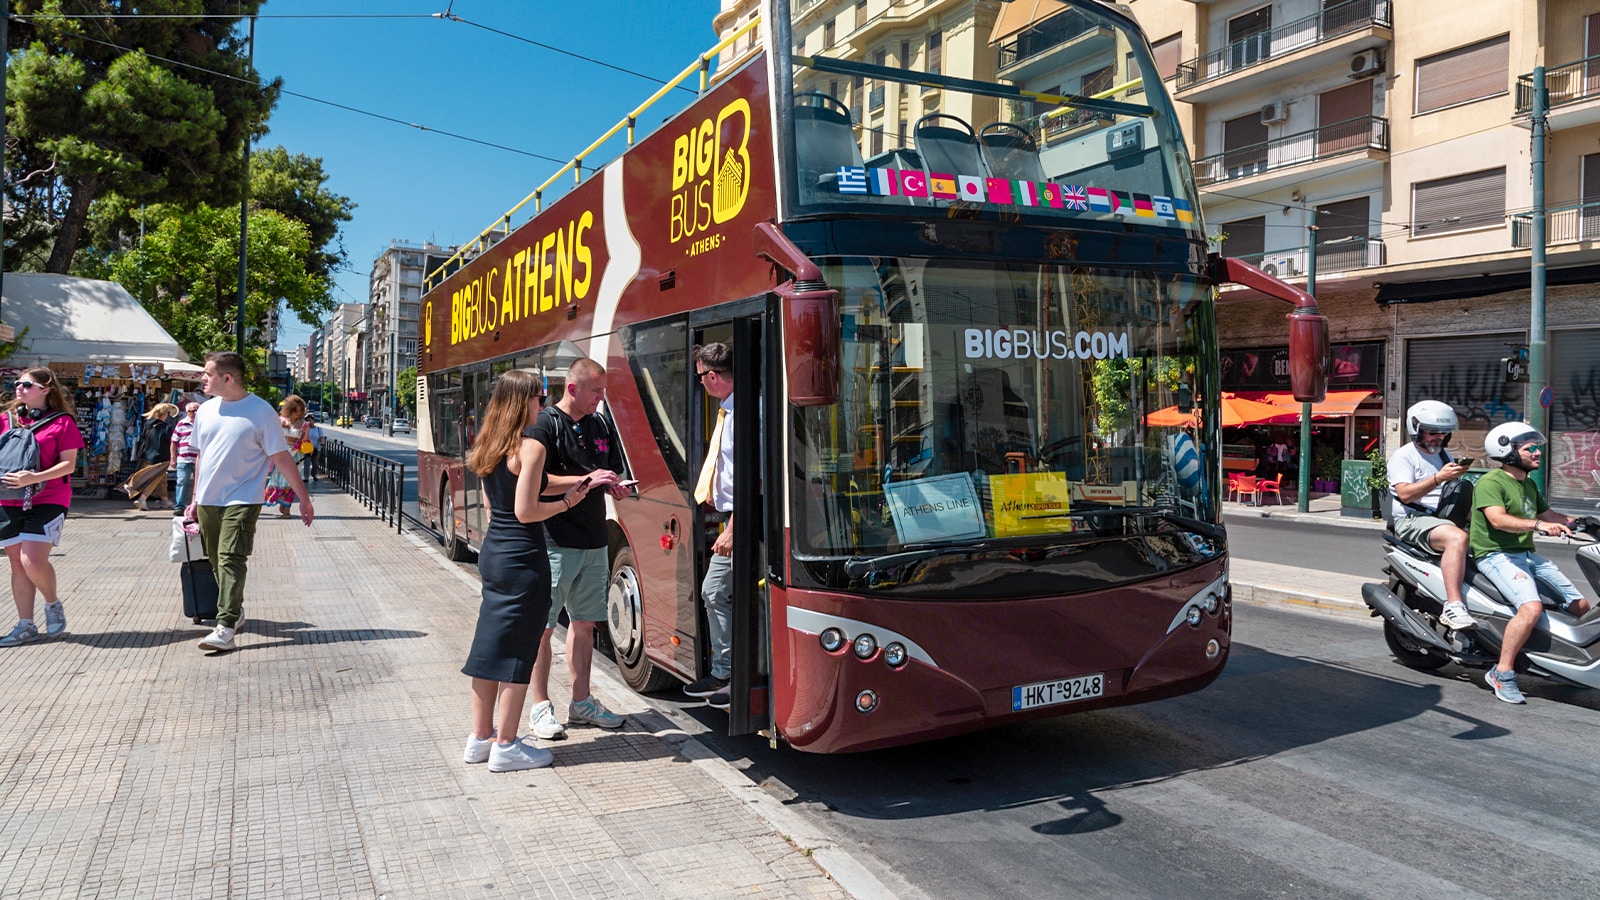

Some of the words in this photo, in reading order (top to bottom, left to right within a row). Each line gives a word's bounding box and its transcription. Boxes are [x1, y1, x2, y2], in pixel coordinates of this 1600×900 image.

[672, 118, 714, 192] BIG
[670, 179, 712, 244] BUS
[690, 236, 721, 257] ATHENS
[500, 210, 593, 326] ATHENS
[964, 328, 1129, 360] BIGBUS.COM
[1507, 361, 1525, 380] Coffee
[903, 501, 945, 517] ATHENS
[946, 498, 970, 511] LINE
[1000, 500, 1034, 512] Athens
